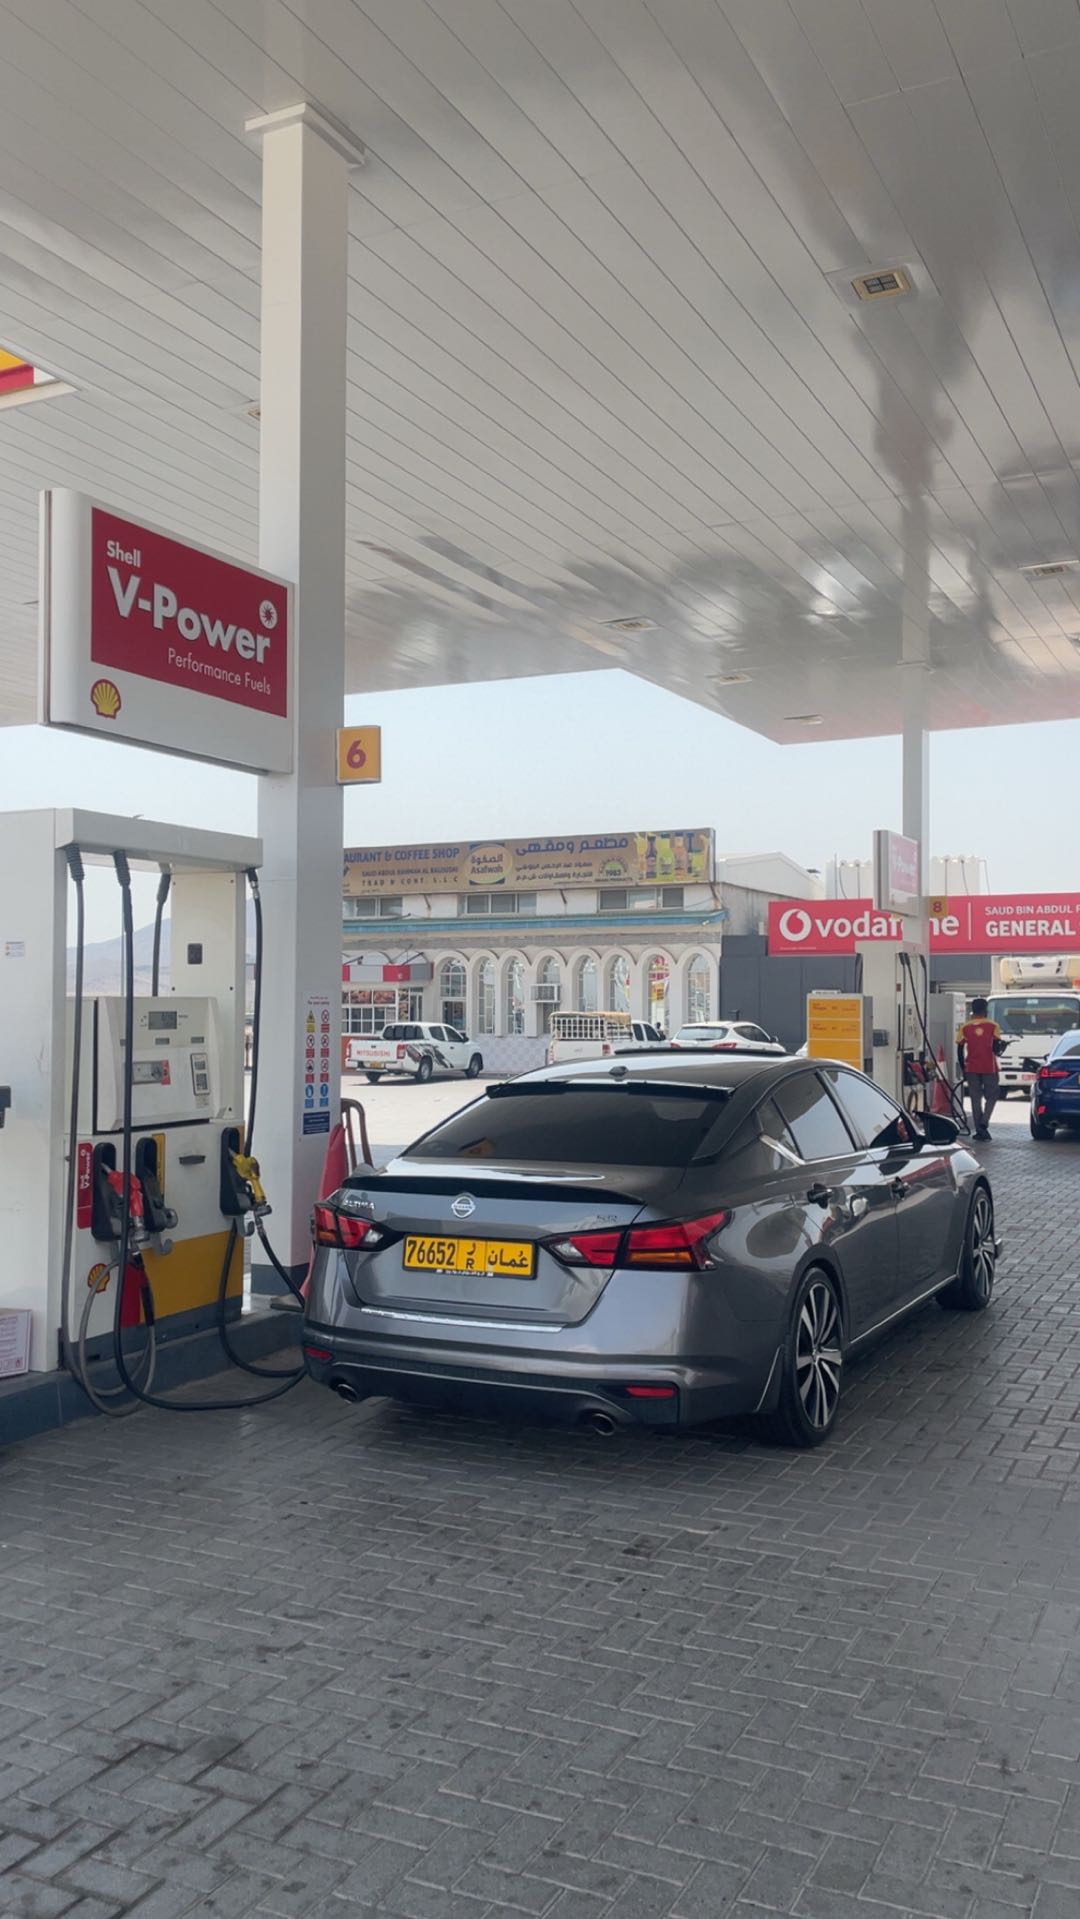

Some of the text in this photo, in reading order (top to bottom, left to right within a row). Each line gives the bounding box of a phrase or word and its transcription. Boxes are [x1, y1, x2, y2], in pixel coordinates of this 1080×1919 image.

[107, 540, 141, 568] Shell
[107, 565, 270, 664] V-Power
[168, 648, 271, 696] Performance Fuels
[346, 739, 366, 769] 6
[385, 851, 392, 862] &
[394, 848, 430, 861] COFFEE
[432, 847, 460, 859] SHOP
[516, 837, 628, 857] مطعم ومقهى
[471, 853, 503, 865] الصفوة
[471, 865, 503, 875] Asafwah
[933, 901, 942, 913] 8
[985, 906, 1014, 916] SAUD
[1016, 905, 1034, 915] BIN
[1036, 904, 1073, 914] ABDUL
[815, 911, 959, 938] vodafne
[985, 919, 1076, 937] GENERAL
[406, 1240, 456, 1266] 76652
[465, 1258, 475, 1270] R
